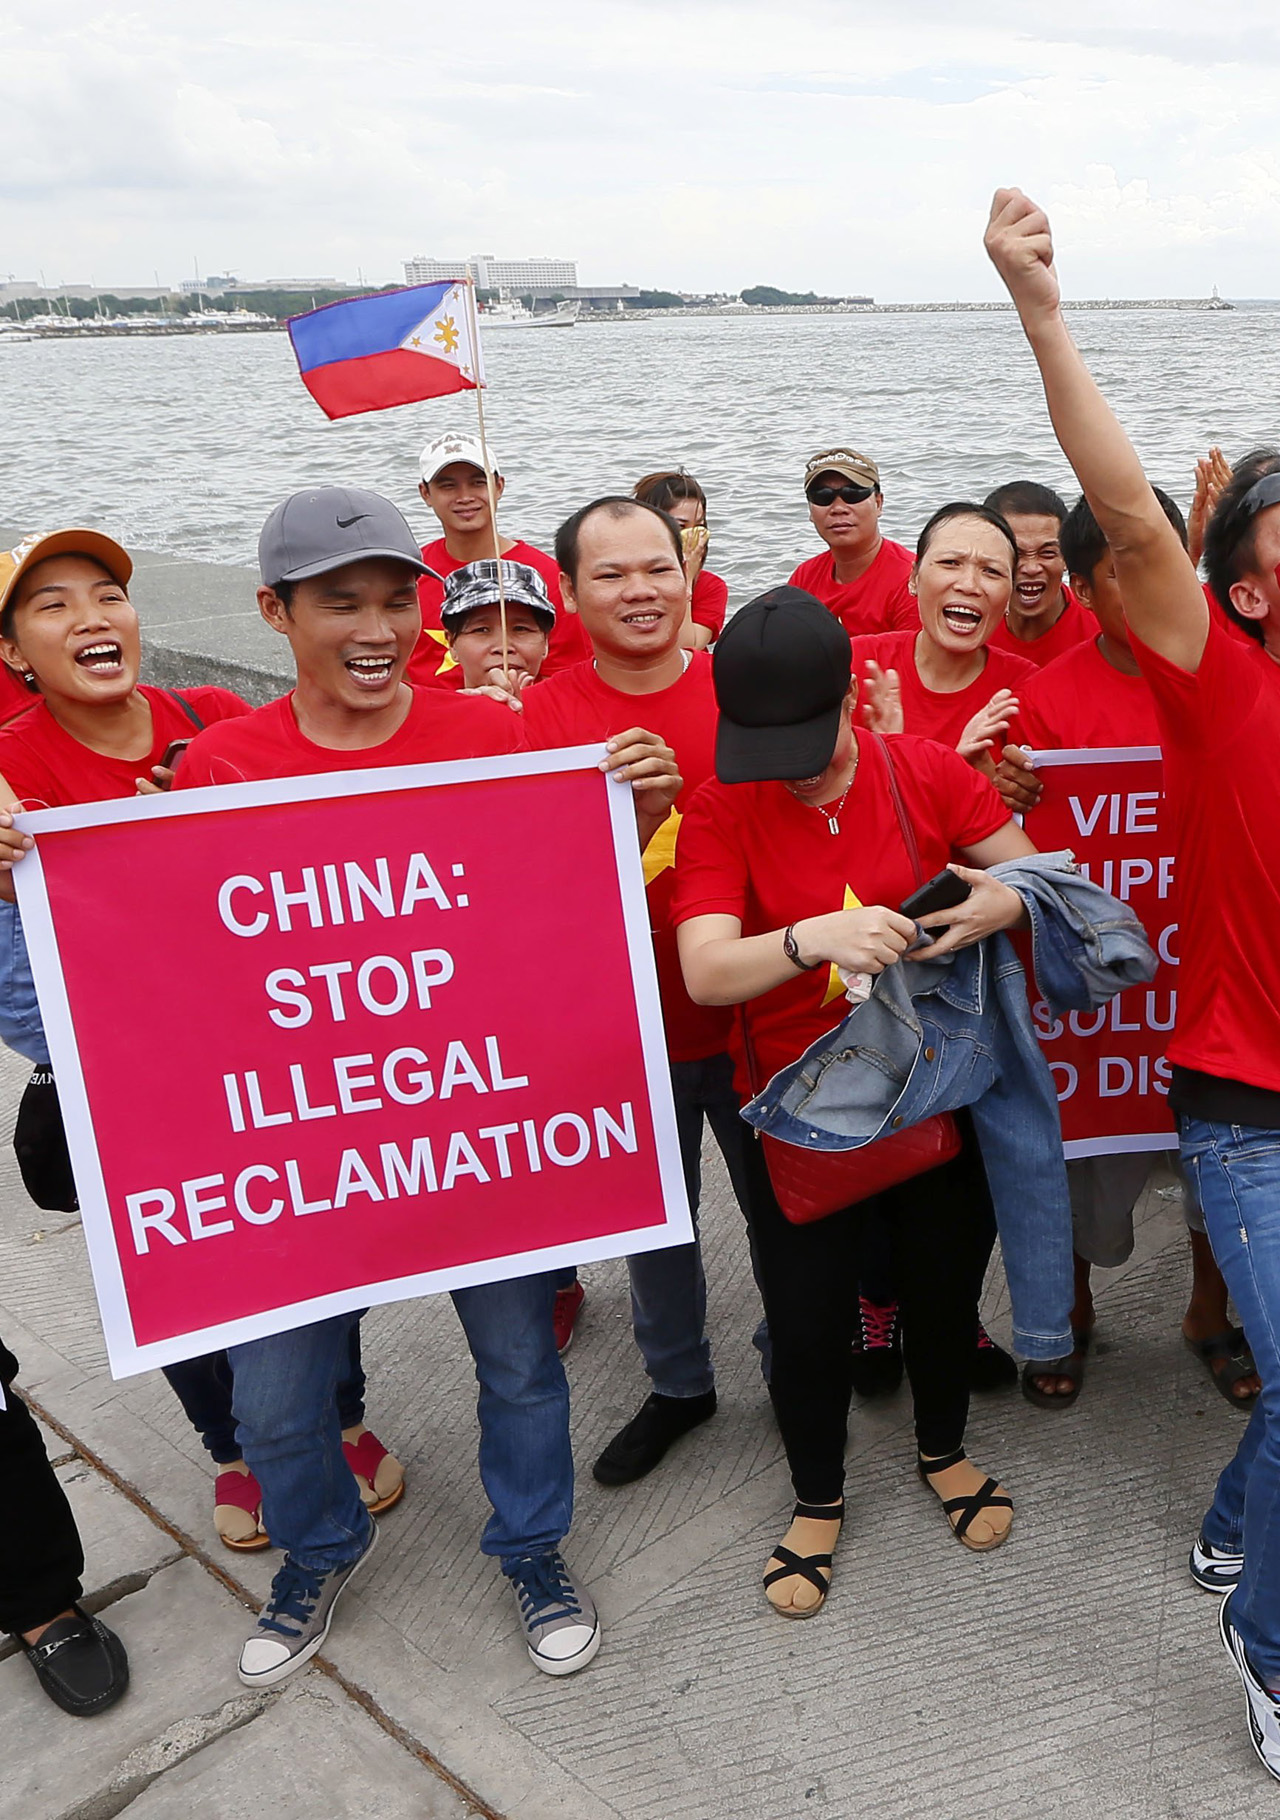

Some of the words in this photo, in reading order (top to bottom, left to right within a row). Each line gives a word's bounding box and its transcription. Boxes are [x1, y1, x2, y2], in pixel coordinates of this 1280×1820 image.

[1067, 791, 1166, 837] VIE
[217, 852, 470, 938] CHINA:
[265, 948, 455, 1029] STOP
[222, 1035, 529, 1133] ILLEGAL
[125, 1101, 638, 1256] RECLAMATION
